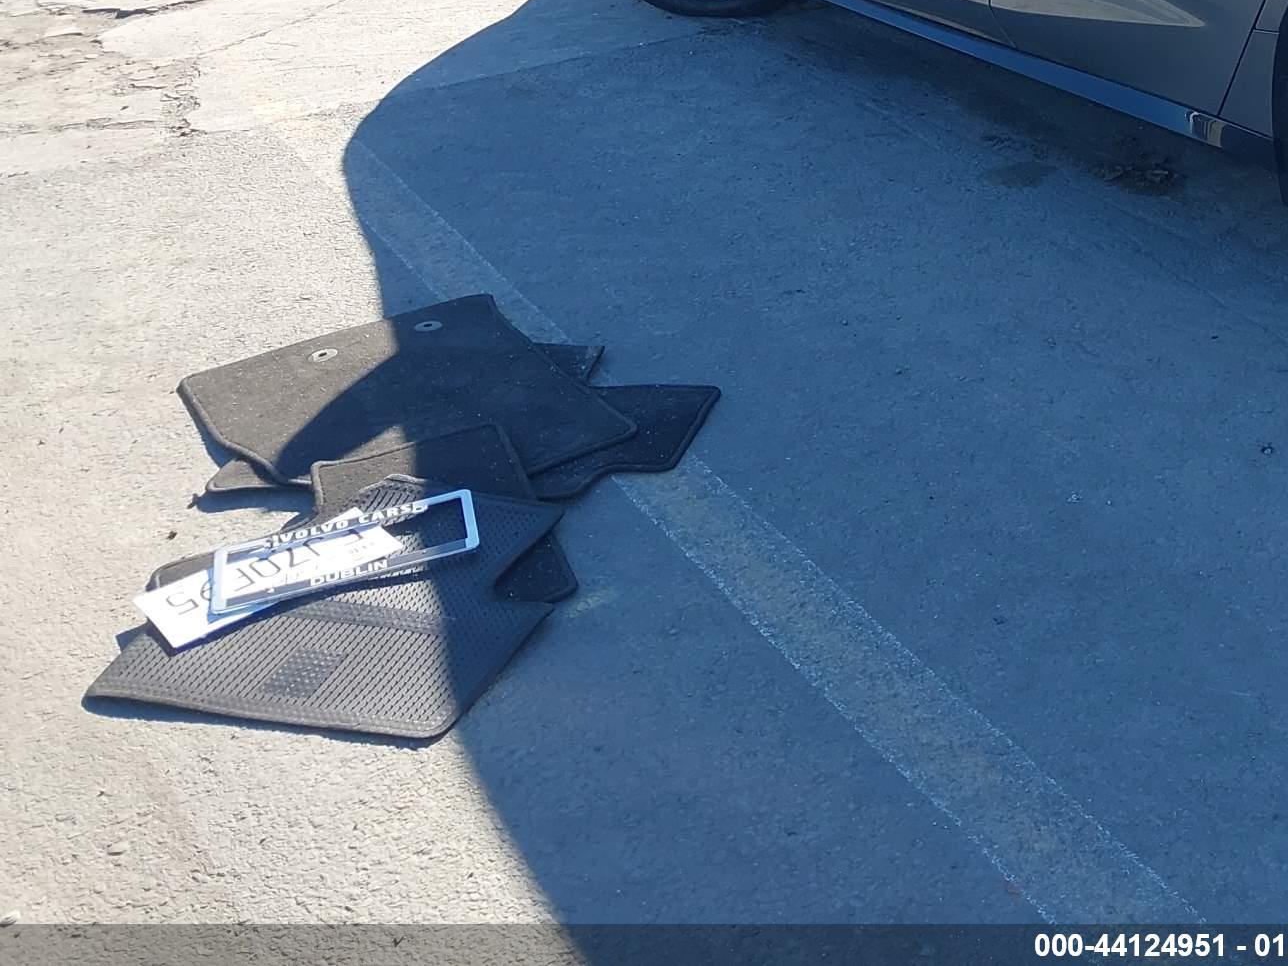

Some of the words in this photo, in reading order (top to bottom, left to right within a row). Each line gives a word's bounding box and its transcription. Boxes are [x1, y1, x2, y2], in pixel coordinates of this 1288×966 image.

[280, 519, 350, 543] VOLVO
[358, 502, 413, 523] CARS
[310, 559, 388, 586] DUBLIN
